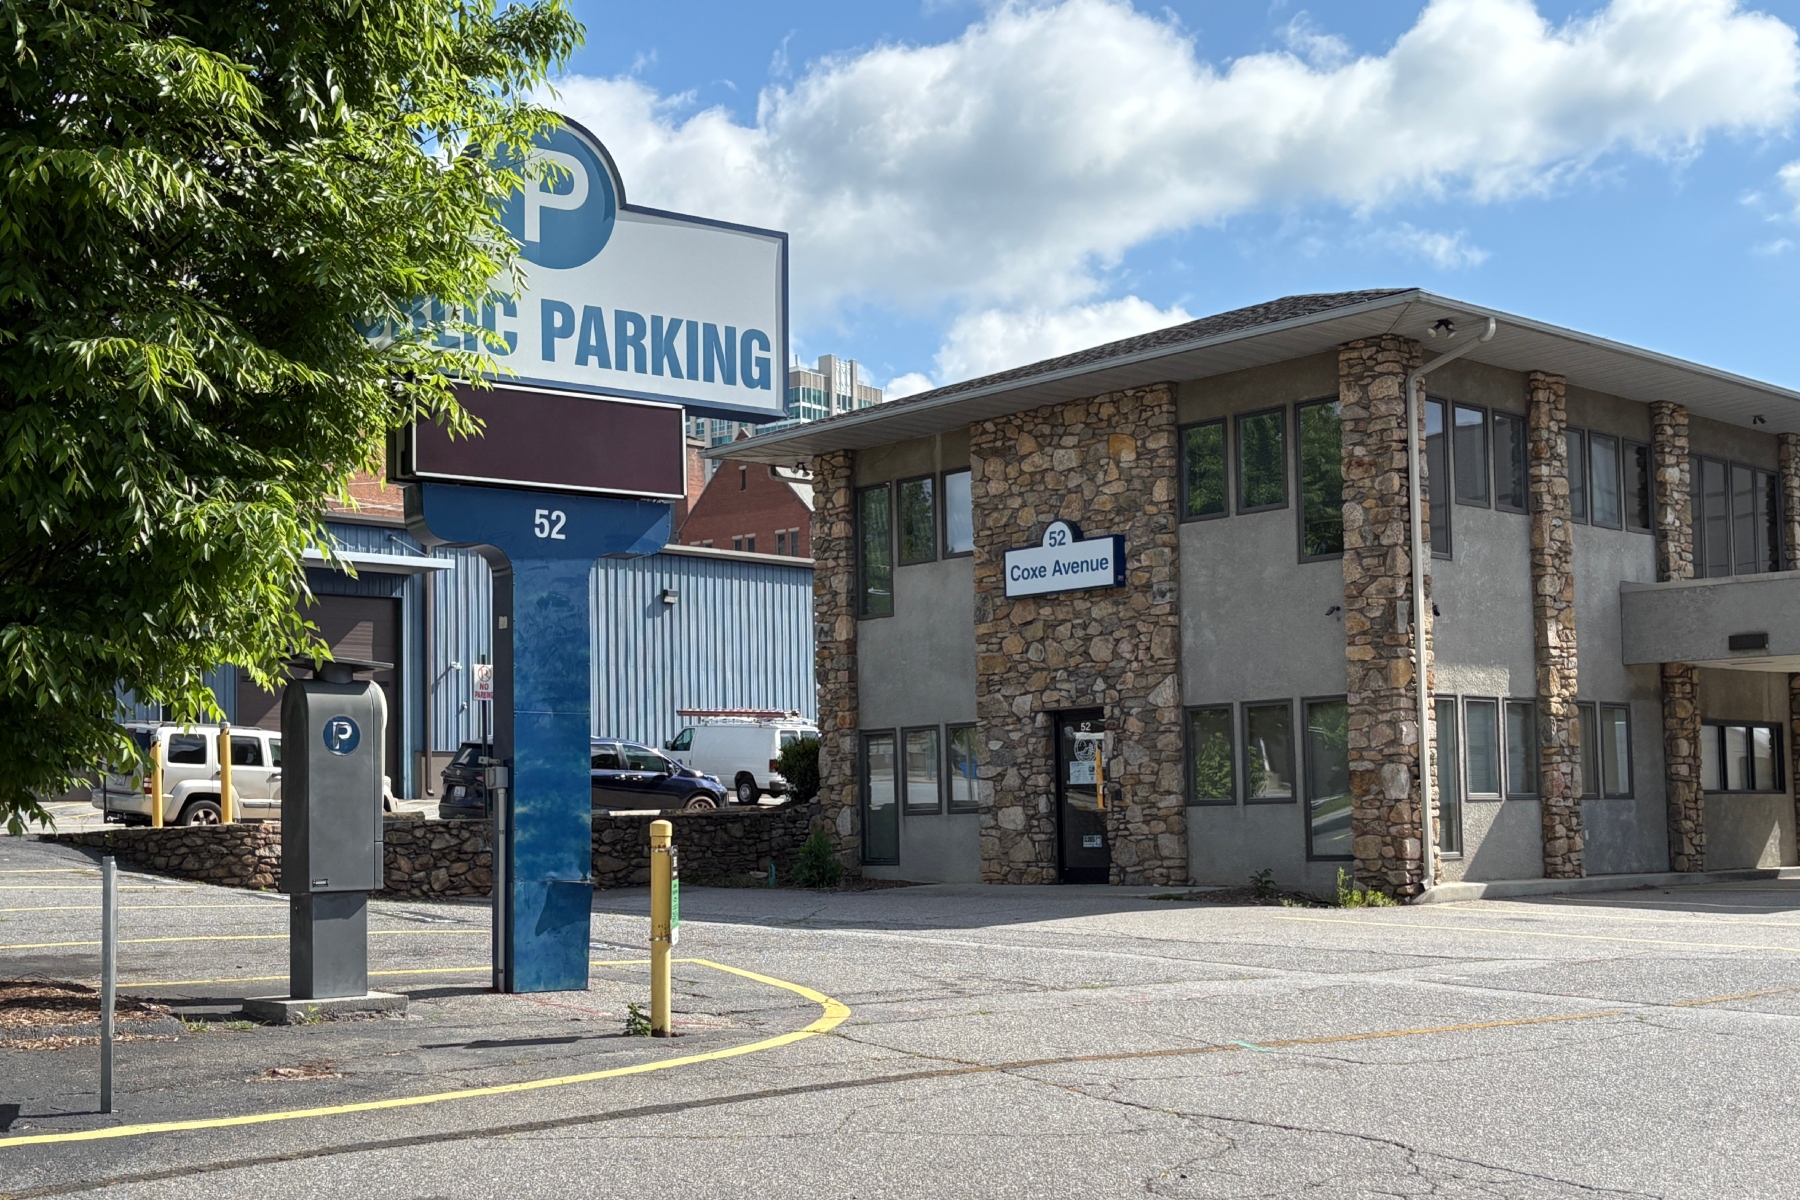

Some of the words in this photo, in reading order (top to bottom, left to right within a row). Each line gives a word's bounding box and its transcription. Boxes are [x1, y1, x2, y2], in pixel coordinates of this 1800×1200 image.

[523, 148, 589, 243] P
[540, 298, 772, 391] PARKING
[534, 508, 567, 540] 52
[1049, 530, 1066, 547] 52
[1011, 565, 1047, 581] Coxe
[1052, 557, 1109, 577] Avenue
[332, 722, 352, 749] P
[1080, 722, 1091, 731] 52
